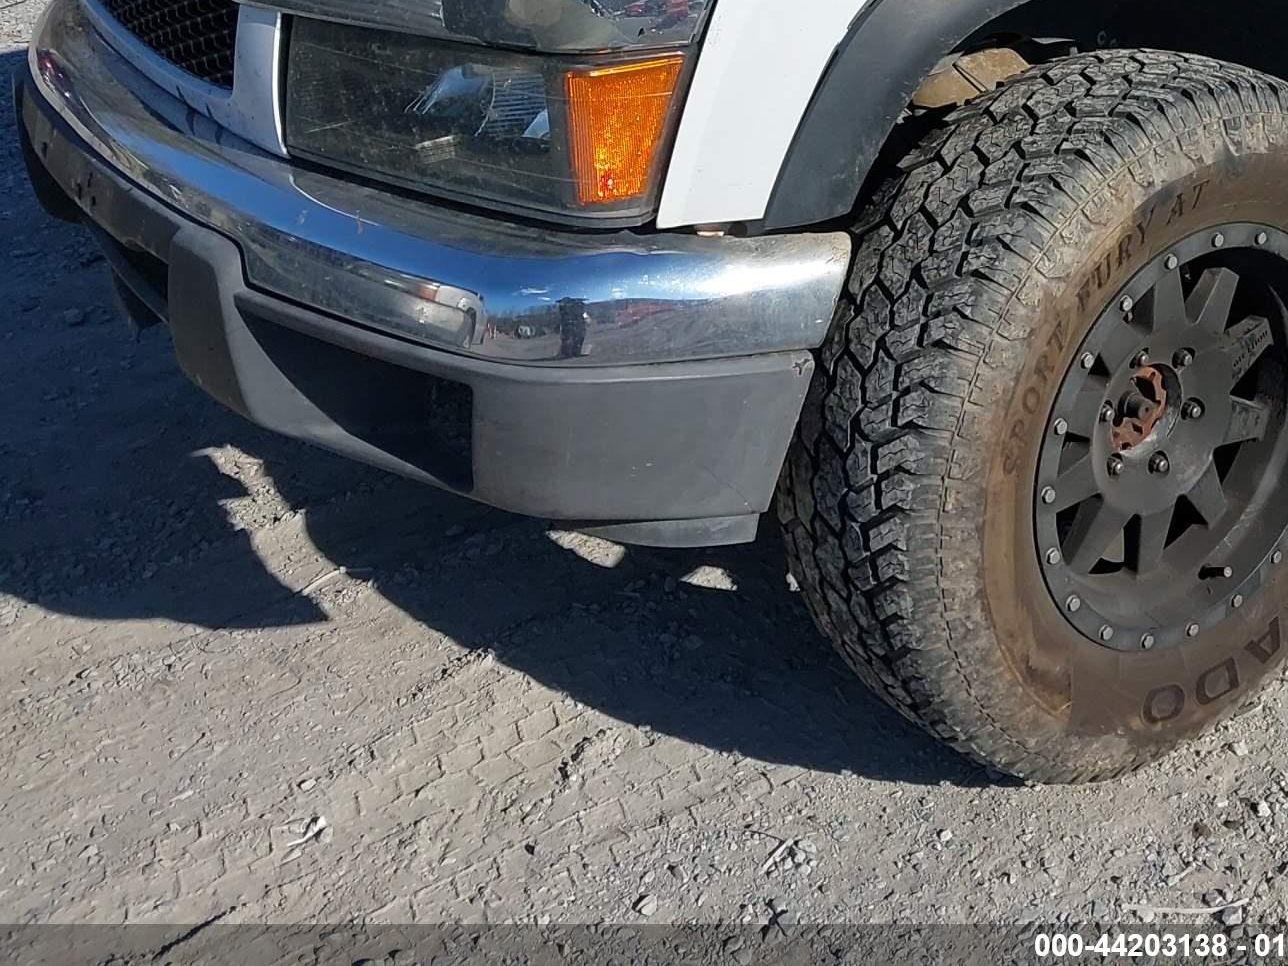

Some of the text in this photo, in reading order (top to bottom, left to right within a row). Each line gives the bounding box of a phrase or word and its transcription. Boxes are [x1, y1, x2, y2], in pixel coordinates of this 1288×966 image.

[1002, 179, 1211, 476] SPORT FURY AT
